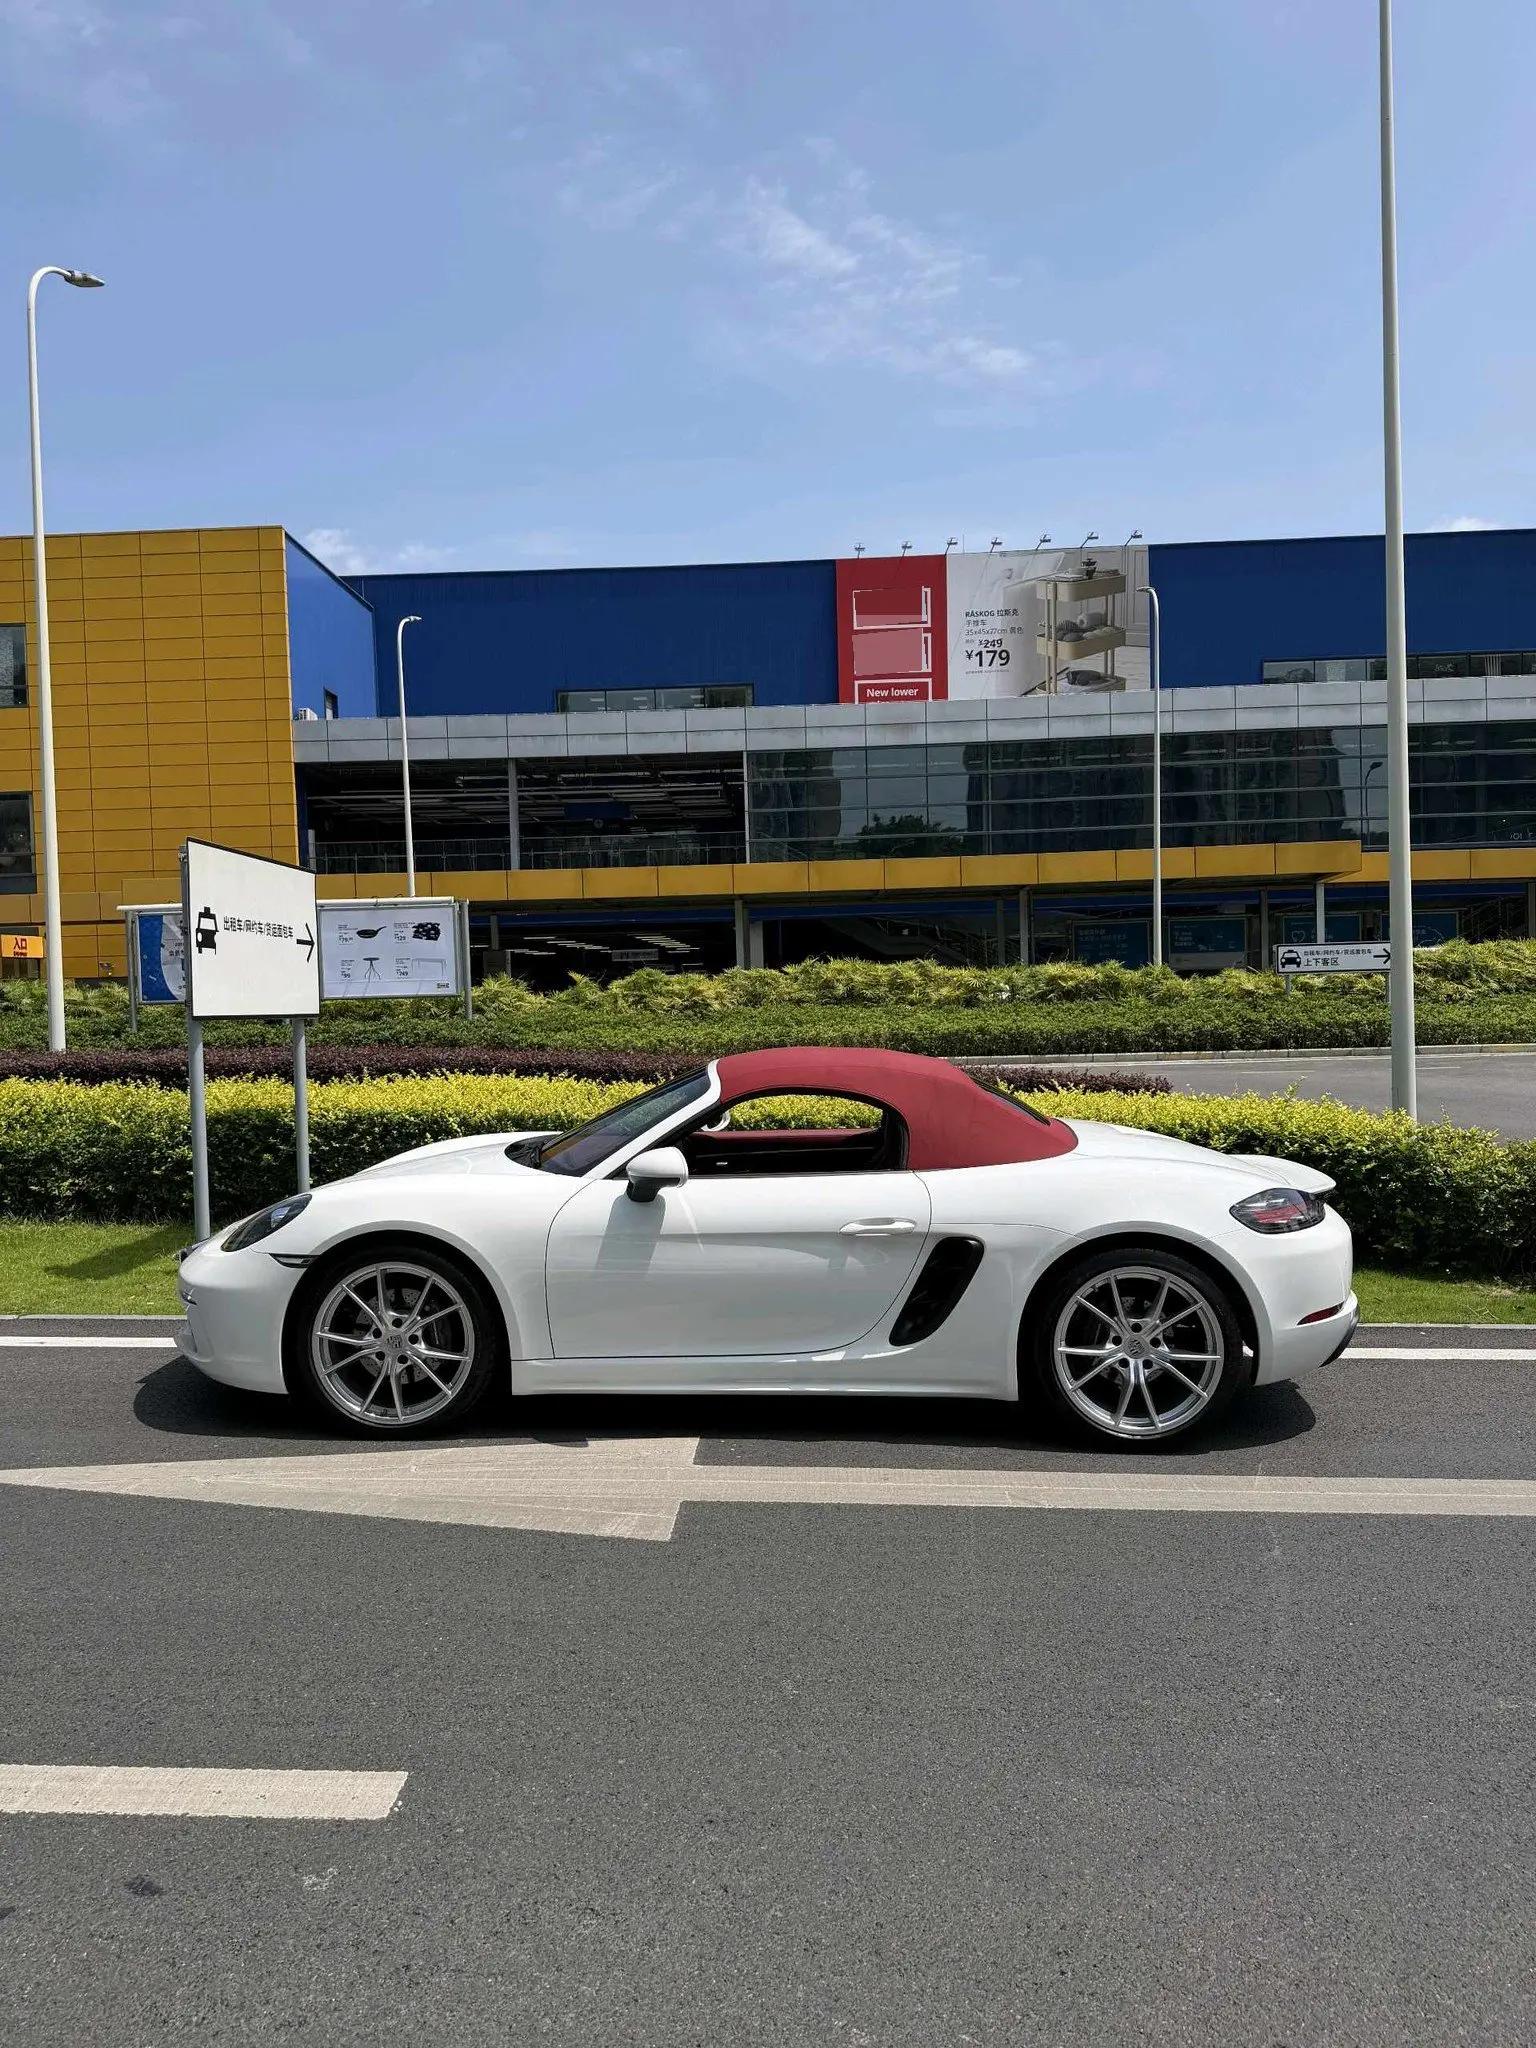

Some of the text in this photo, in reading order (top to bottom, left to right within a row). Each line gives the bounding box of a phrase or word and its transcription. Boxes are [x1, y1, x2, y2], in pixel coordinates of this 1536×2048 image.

[965, 610, 995, 618] RÅSKOG
[965, 649, 1011, 667] ¥179
[866, 687, 919, 698] New lower
[13, 936, 28, 950] 入口
[1303, 957, 1340, 967] 上下客区
